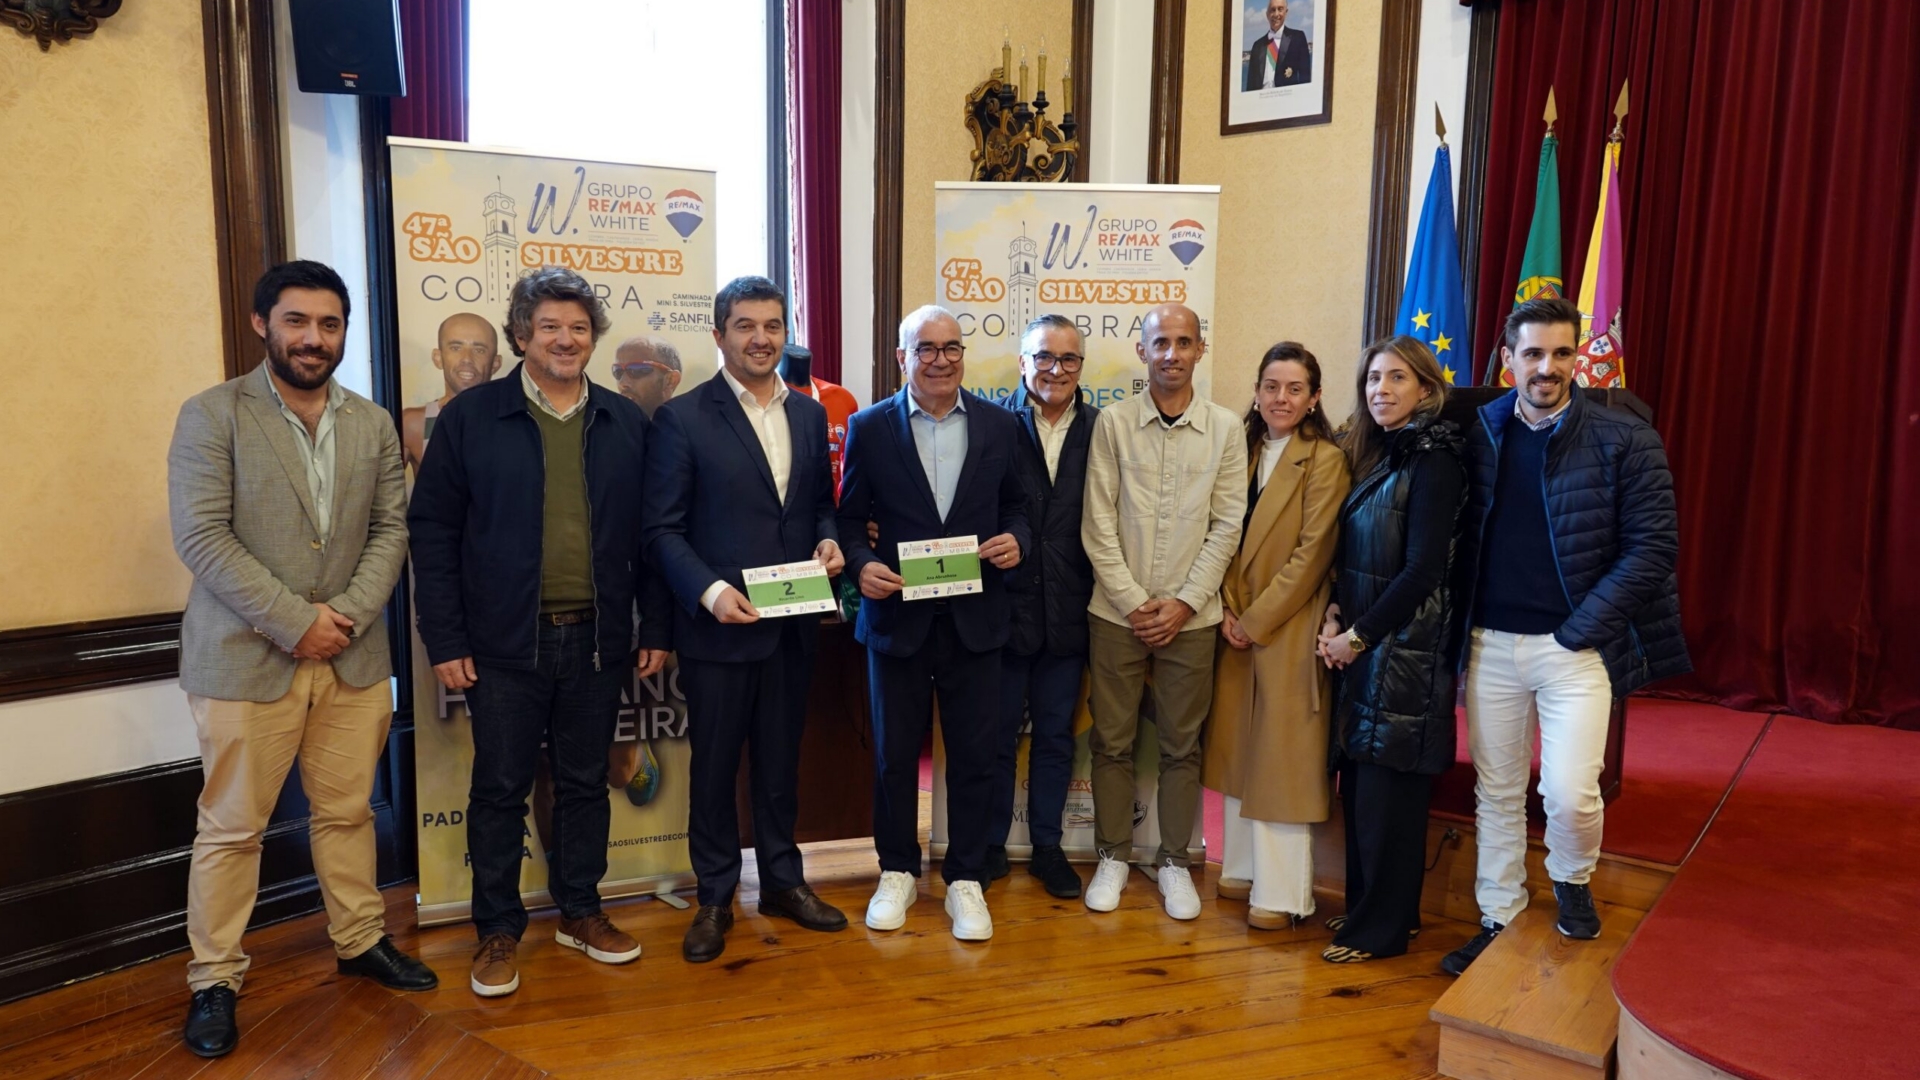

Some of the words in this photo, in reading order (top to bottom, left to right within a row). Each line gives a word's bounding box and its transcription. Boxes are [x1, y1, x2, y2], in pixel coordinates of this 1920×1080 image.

[587, 182, 652, 200] GRUPO
[588, 198, 657, 216] RE/MAX
[668, 201, 701, 212] RE/MAX
[590, 214, 650, 231] WHITE
[1098, 218, 1158, 232] GRUPO
[1098, 233, 1161, 247] RE/MAX
[1171, 230, 1202, 241] RE/MAX
[411, 232, 479, 262] SÃO
[1099, 248, 1154, 261] WHITE
[523, 243, 682, 273] SILVESTRE
[947, 274, 1004, 301] SÃO
[1040, 280, 1185, 302] SILVESTRE
[672, 293, 712, 301] CAMINHADA
[680, 301, 712, 309] SILVESTRE
[669, 312, 714, 325] SANFIL
[936, 558, 945, 574] 1
[782, 581, 796, 596] 2
